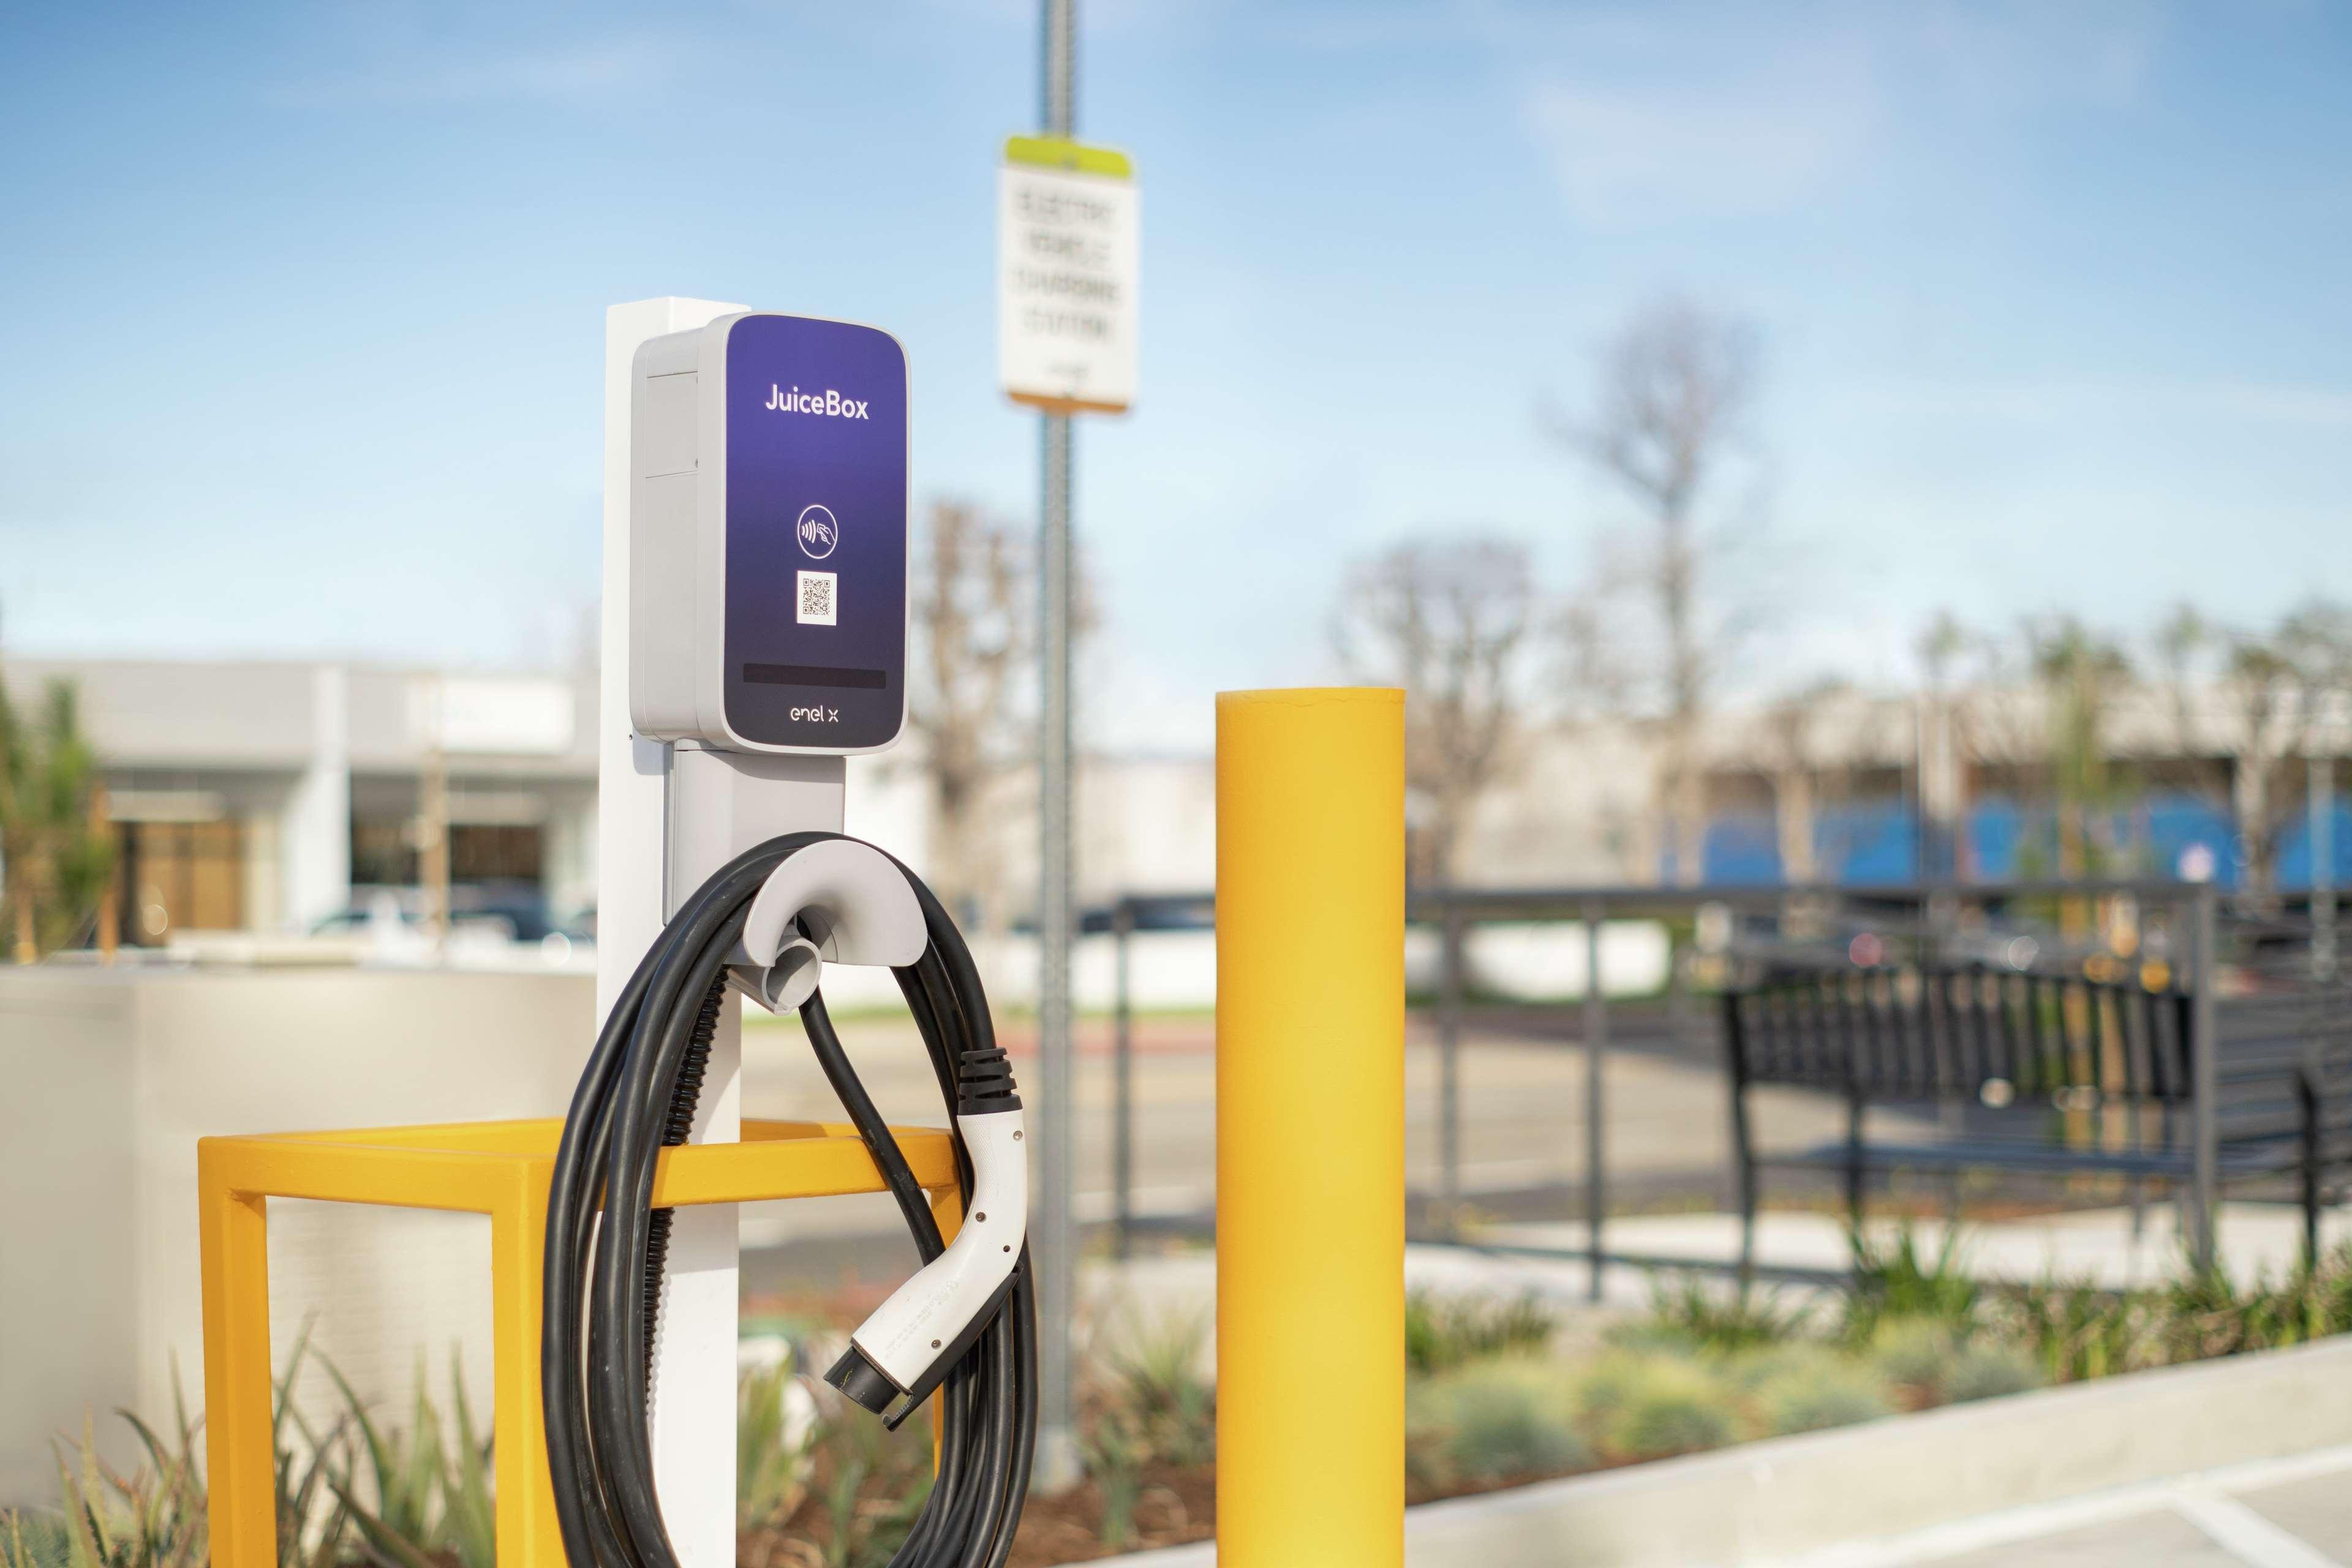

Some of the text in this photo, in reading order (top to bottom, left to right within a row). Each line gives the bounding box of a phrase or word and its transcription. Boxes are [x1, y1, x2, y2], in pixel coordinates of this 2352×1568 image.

[766, 384, 869, 420] JuiceBox
[790, 705, 839, 723] enel x
